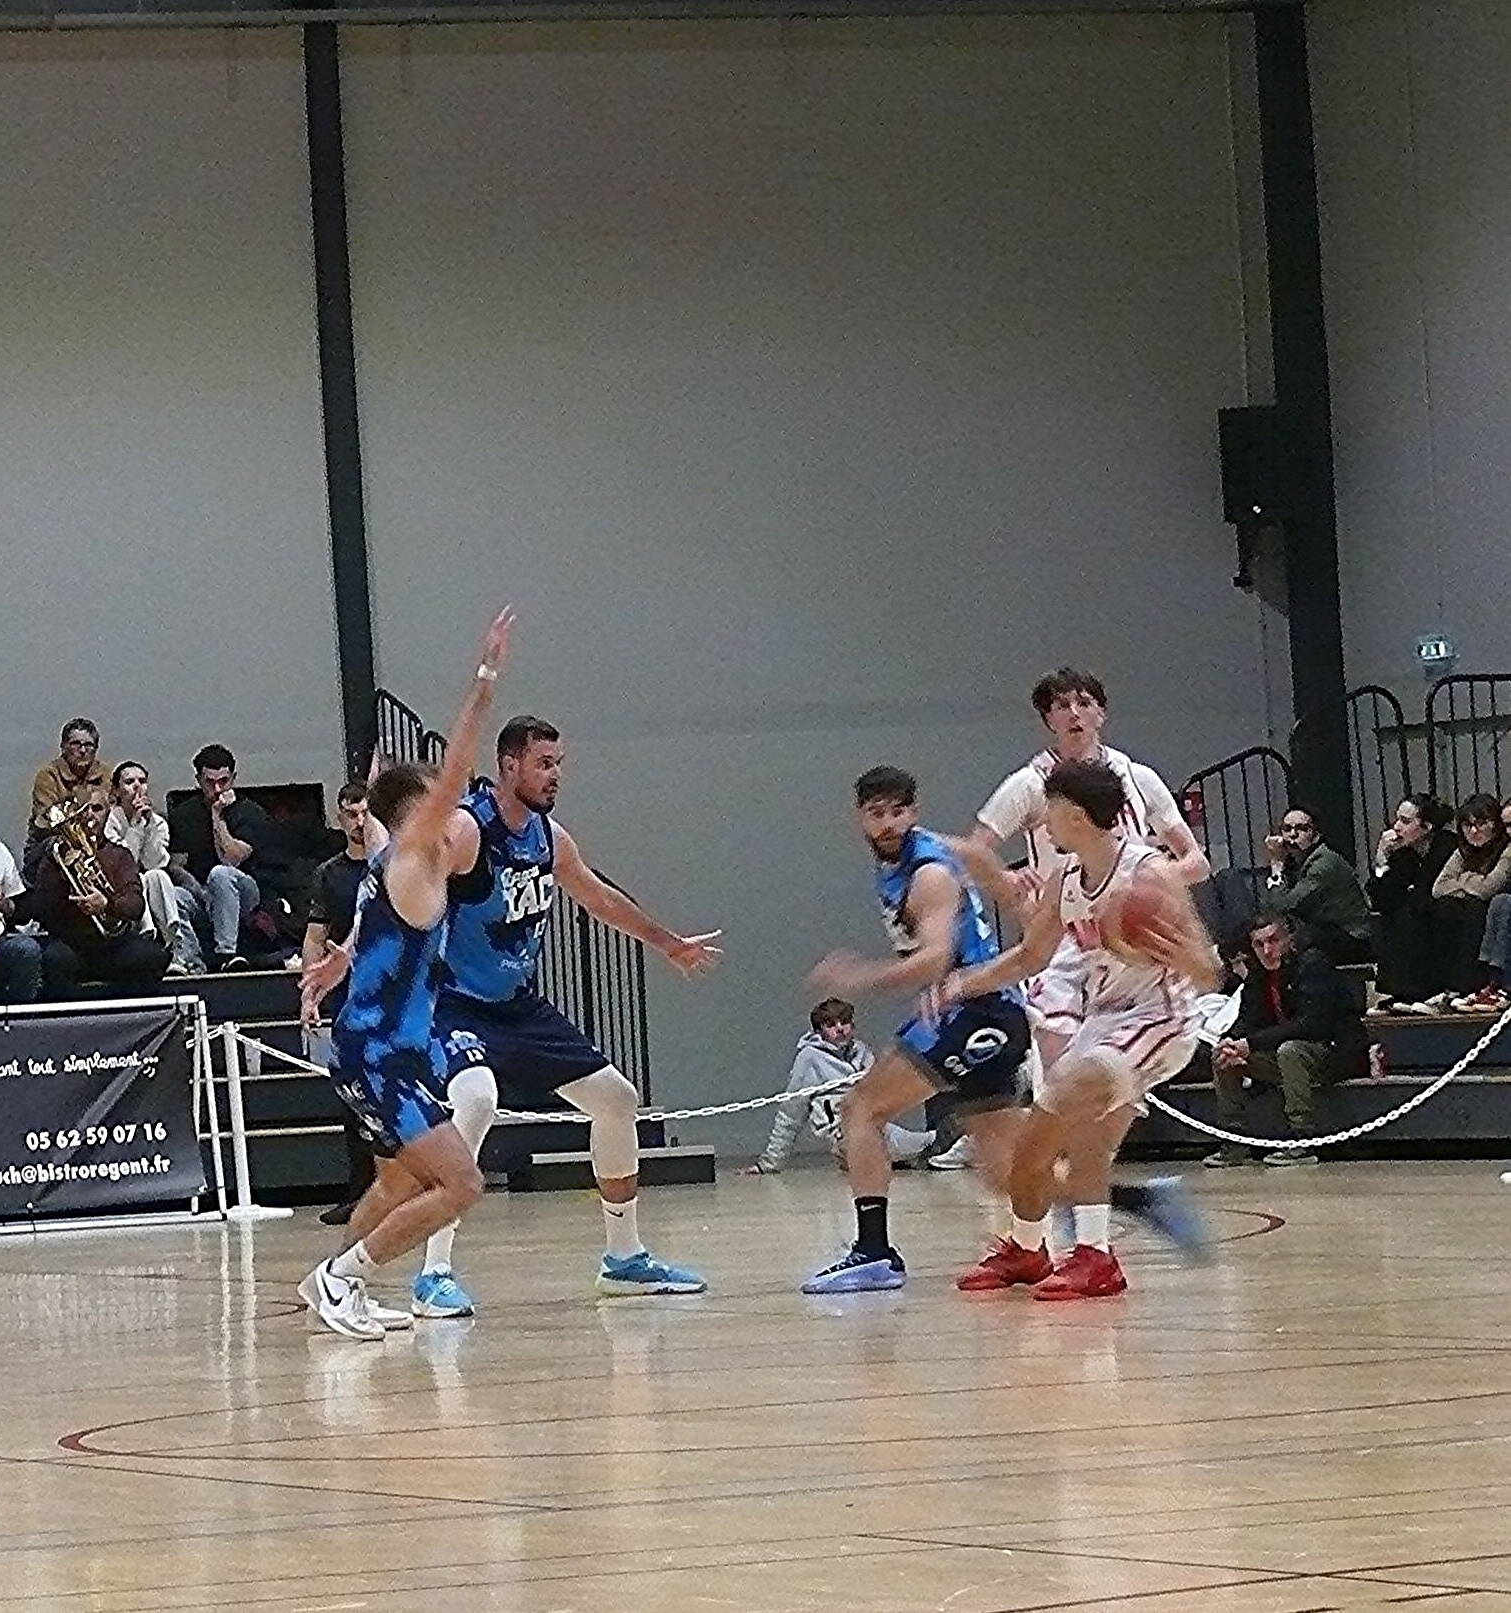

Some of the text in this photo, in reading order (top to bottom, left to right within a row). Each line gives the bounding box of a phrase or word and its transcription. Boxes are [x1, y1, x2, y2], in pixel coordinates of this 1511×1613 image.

[28, 1057, 57, 1075] tout
[25, 1121, 167, 1151] 05 62 59 07 16
